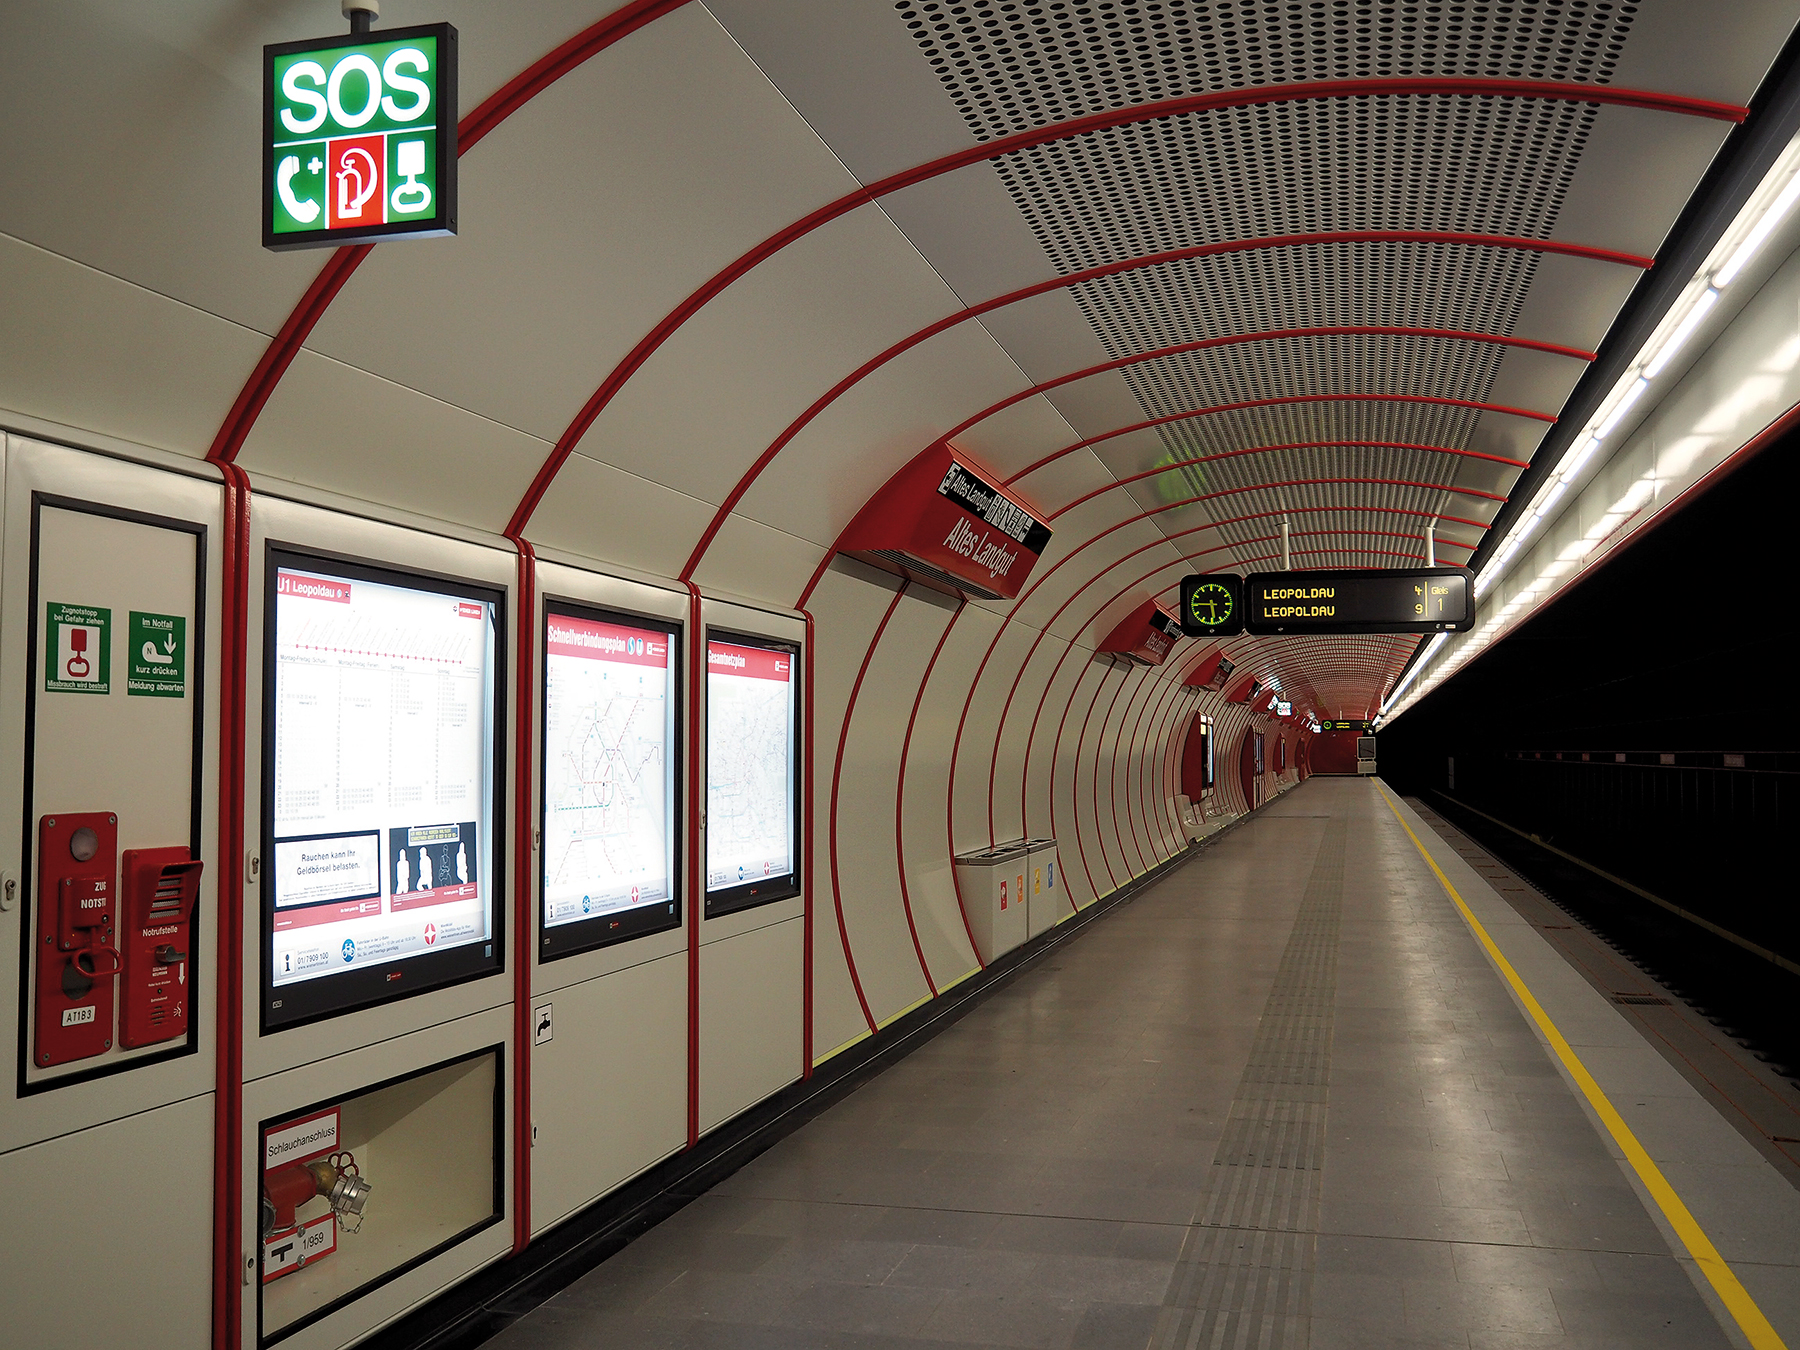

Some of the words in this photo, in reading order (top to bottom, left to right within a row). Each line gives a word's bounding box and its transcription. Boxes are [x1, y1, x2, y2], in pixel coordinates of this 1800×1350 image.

[280, 46, 431, 134] SOS
[950, 474, 970, 497] Altes
[966, 483, 993, 512] Landgut
[943, 516, 979, 557] Altes
[972, 532, 1018, 578] Landgut
[278, 576, 290, 592] U1
[293, 581, 334, 597] Leopoldau
[1263, 588, 1335, 600] LEOPOLDAU
[1414, 585, 1422, 596] 4
[1431, 586, 1449, 595] Gleis
[61, 605, 98, 617] Zugnotstopp
[1263, 605, 1335, 618] LEOPOLDAU
[1414, 603, 1424, 614] 9
[1437, 597, 1443, 611] 1
[65, 614, 84, 623] Gefahr
[86, 617, 104, 625] ziehen
[142, 618, 150, 626] Im
[152, 619, 173, 629] Notfall
[548, 625, 626, 654] Schnellverbindungsplan
[708, 649, 746, 669] Gesamtnetzplan
[136, 665, 150, 674] kurz
[152, 666, 178, 676] drücken
[48, 680, 76, 688] Missbrauch
[128, 680, 154, 692] Meldung
[156, 682, 184, 691] abwarten
[301, 853, 330, 862] Rauchen
[331, 851, 346, 860] kann
[347, 850, 356, 858] Ihr
[297, 865, 331, 876] Geldbörsel
[333, 862, 360, 872] belasten.
[142, 926, 177, 937] Notrufstelle
[297, 954, 318, 964] 01/7909
[320, 952, 329, 960] 100
[67, 1010, 92, 1022] AT1B3
[268, 1126, 335, 1157] Schlauchanschluss
[302, 1232, 324, 1250] 1/959
